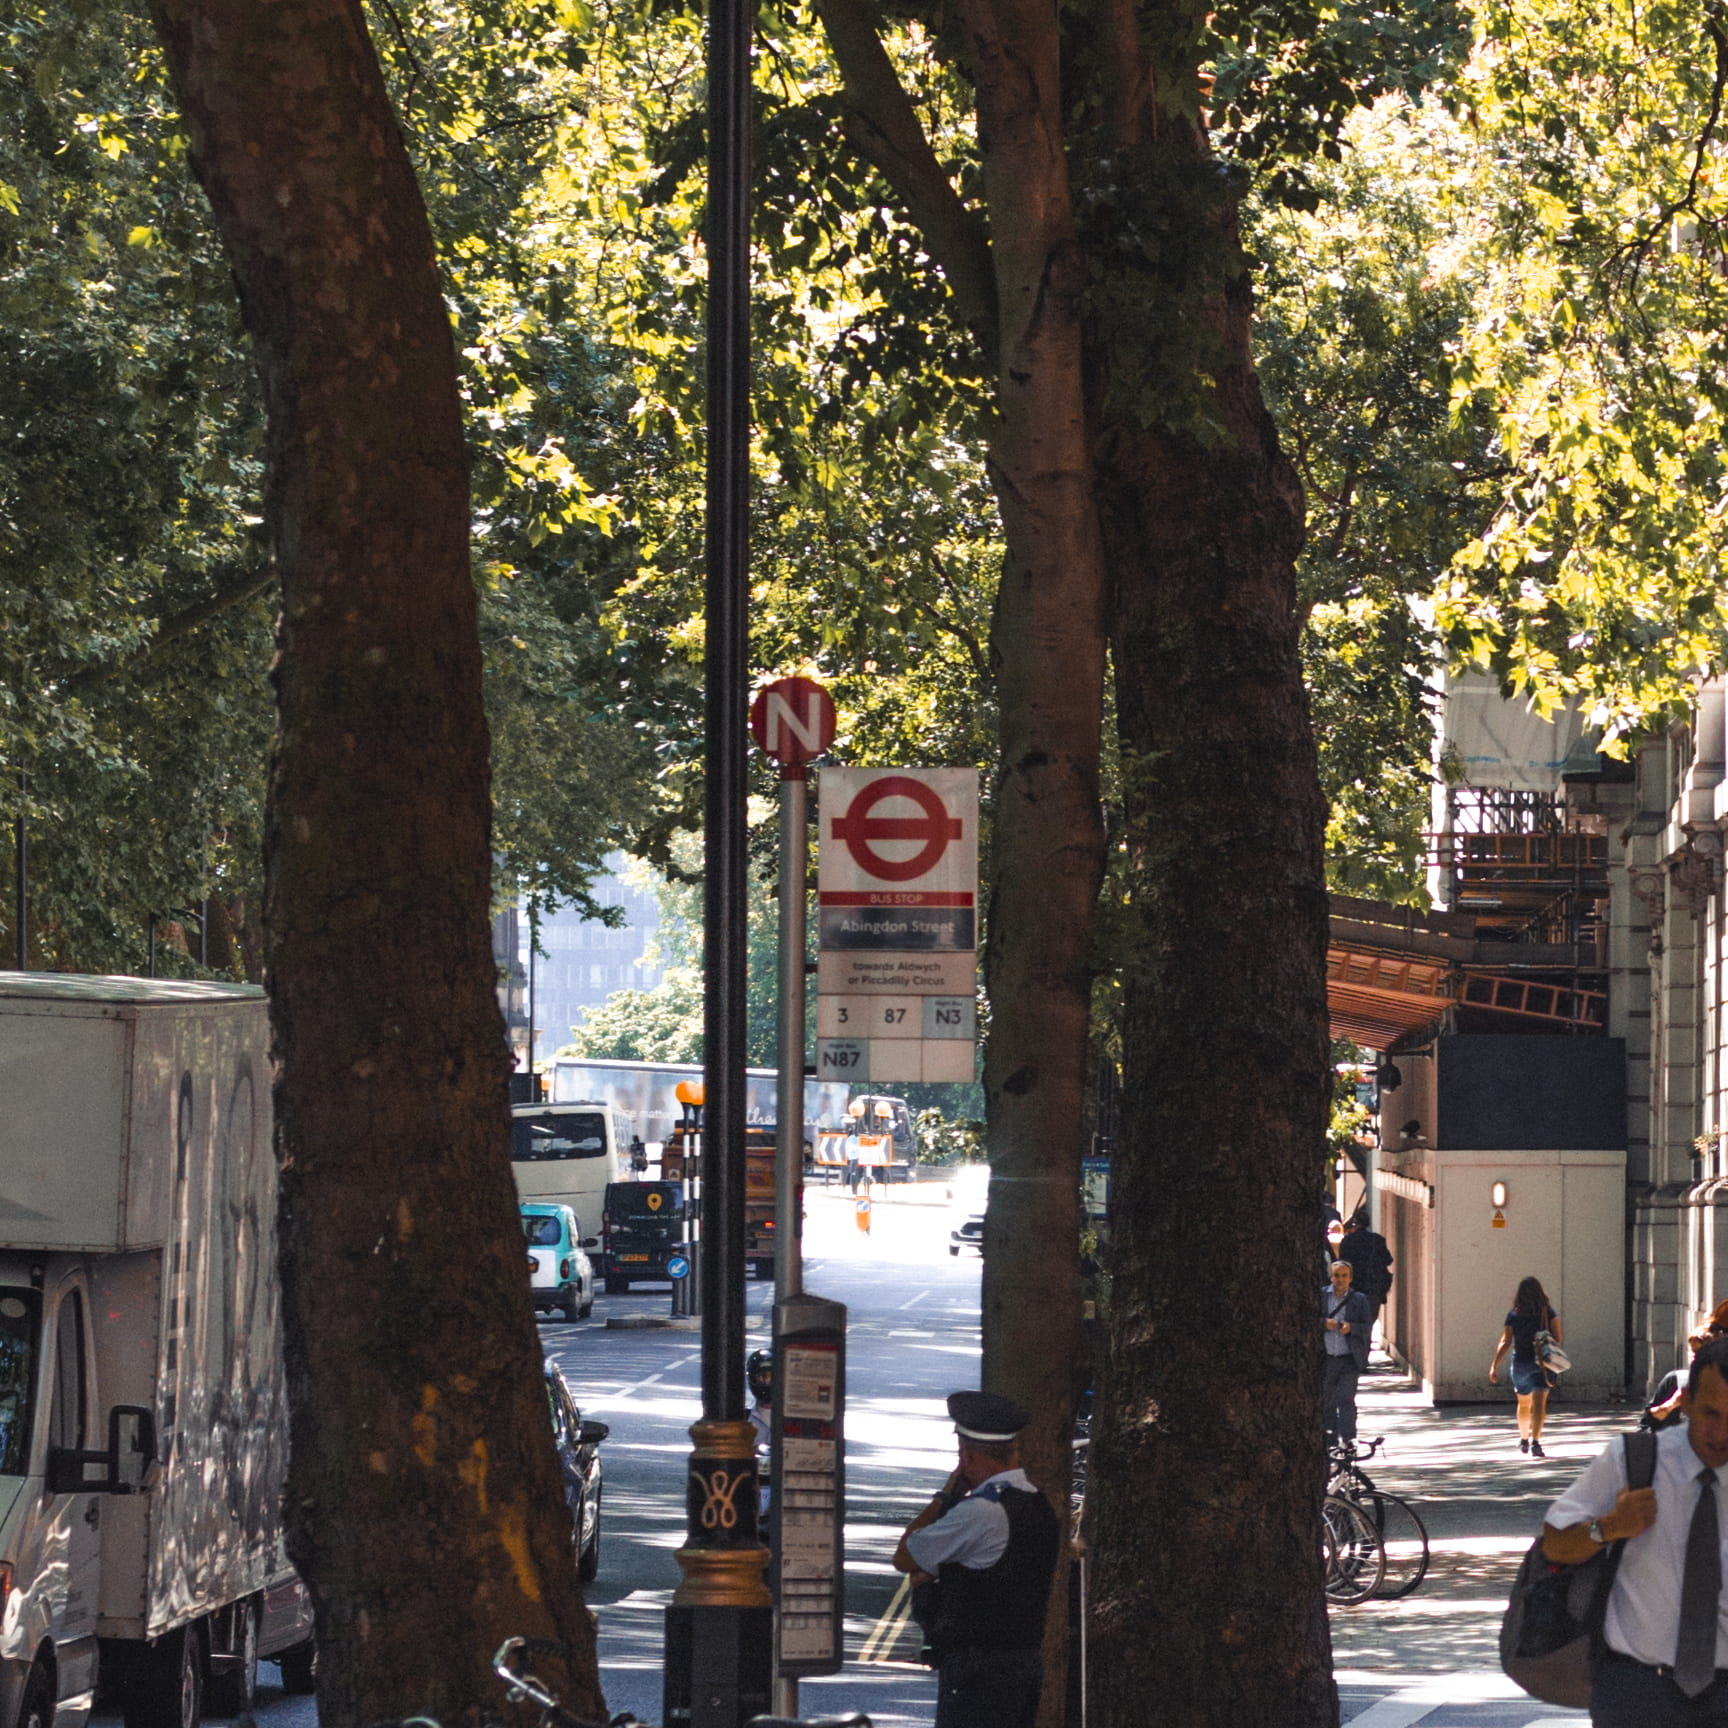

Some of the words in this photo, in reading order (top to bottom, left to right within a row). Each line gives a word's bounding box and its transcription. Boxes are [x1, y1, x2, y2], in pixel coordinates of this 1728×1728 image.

[766, 691, 821, 752] N
[869, 894, 892, 904] BUS
[895, 894, 923, 904] STOP
[840, 919, 907, 934] Abingdon
[911, 920, 955, 933] Street
[852, 962, 895, 971] towards
[898, 961, 942, 973] Aldwych
[848, 977, 859, 985] or
[861, 975, 910, 986] Piccadilly
[912, 976, 945, 985] Circus
[837, 1008, 849, 1023] 3
[884, 1008, 906, 1023] 87
[935, 1009, 961, 1024] N3
[823, 1051, 861, 1067] N87
